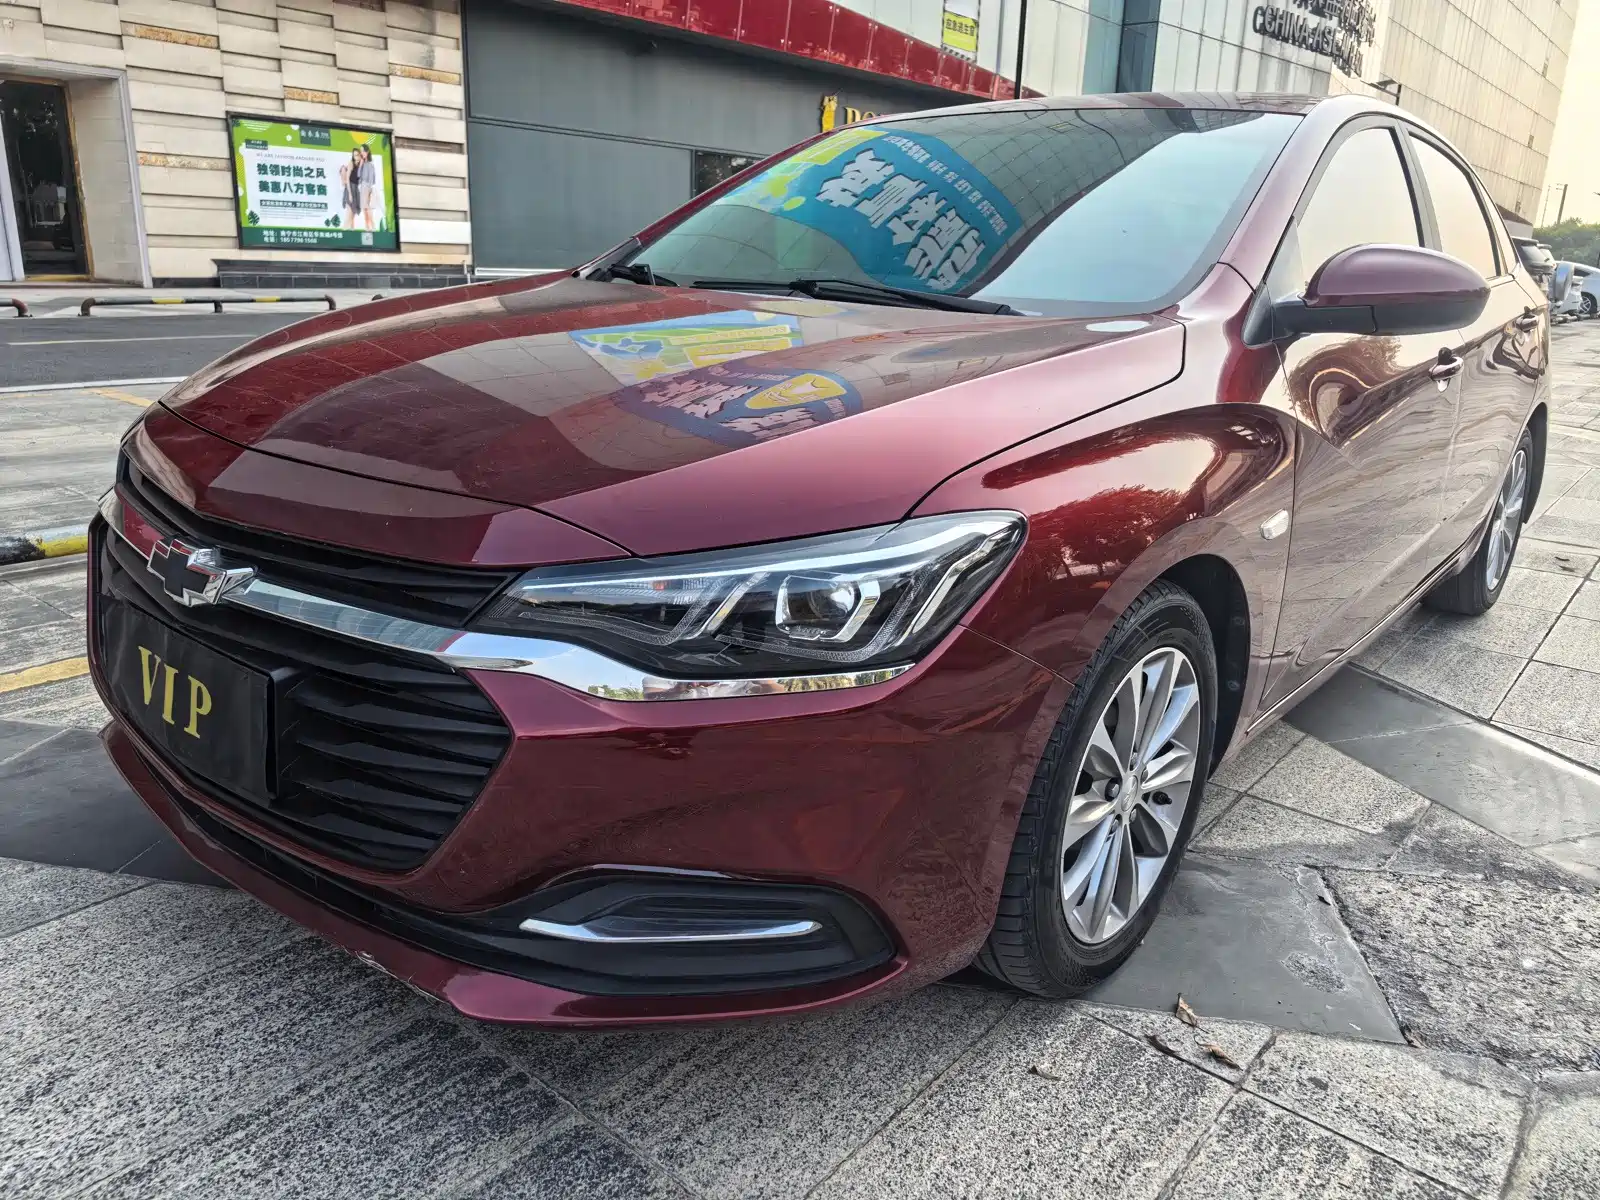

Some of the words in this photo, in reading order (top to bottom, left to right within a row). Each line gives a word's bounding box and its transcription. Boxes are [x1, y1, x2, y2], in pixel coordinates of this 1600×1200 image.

[257, 163, 326, 179] 独领时尚之风
[138, 645, 212, 739] VIP
